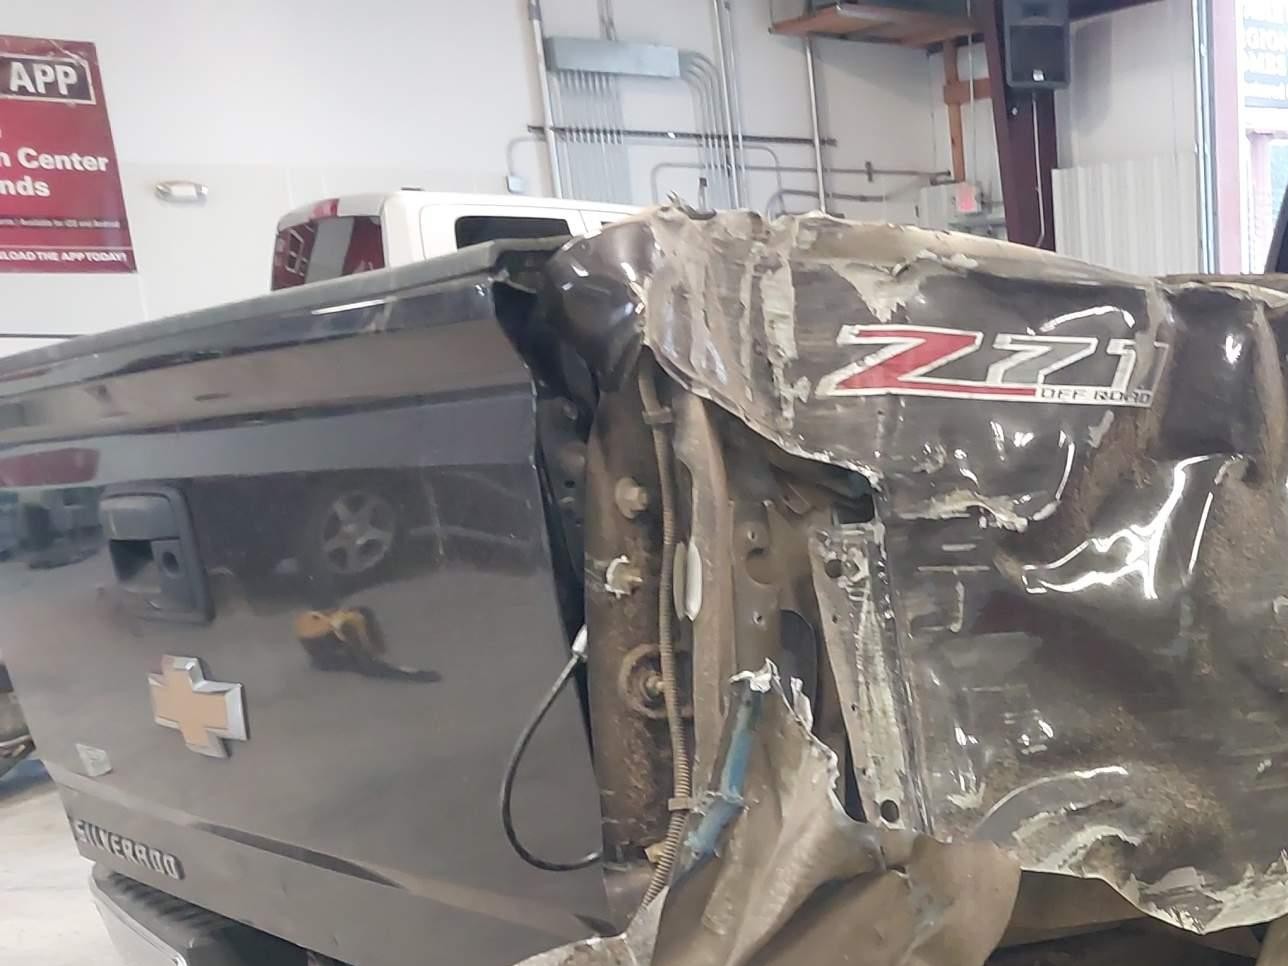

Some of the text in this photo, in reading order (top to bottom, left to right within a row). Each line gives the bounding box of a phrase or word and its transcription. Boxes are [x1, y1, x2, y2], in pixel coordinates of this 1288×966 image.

[9, 61, 78, 95] APP
[17, 146, 109, 171] Center
[0, 175, 50, 197] nds
[815, 324, 1170, 399] Z71
[73, 819, 186, 881] SILVERADO
